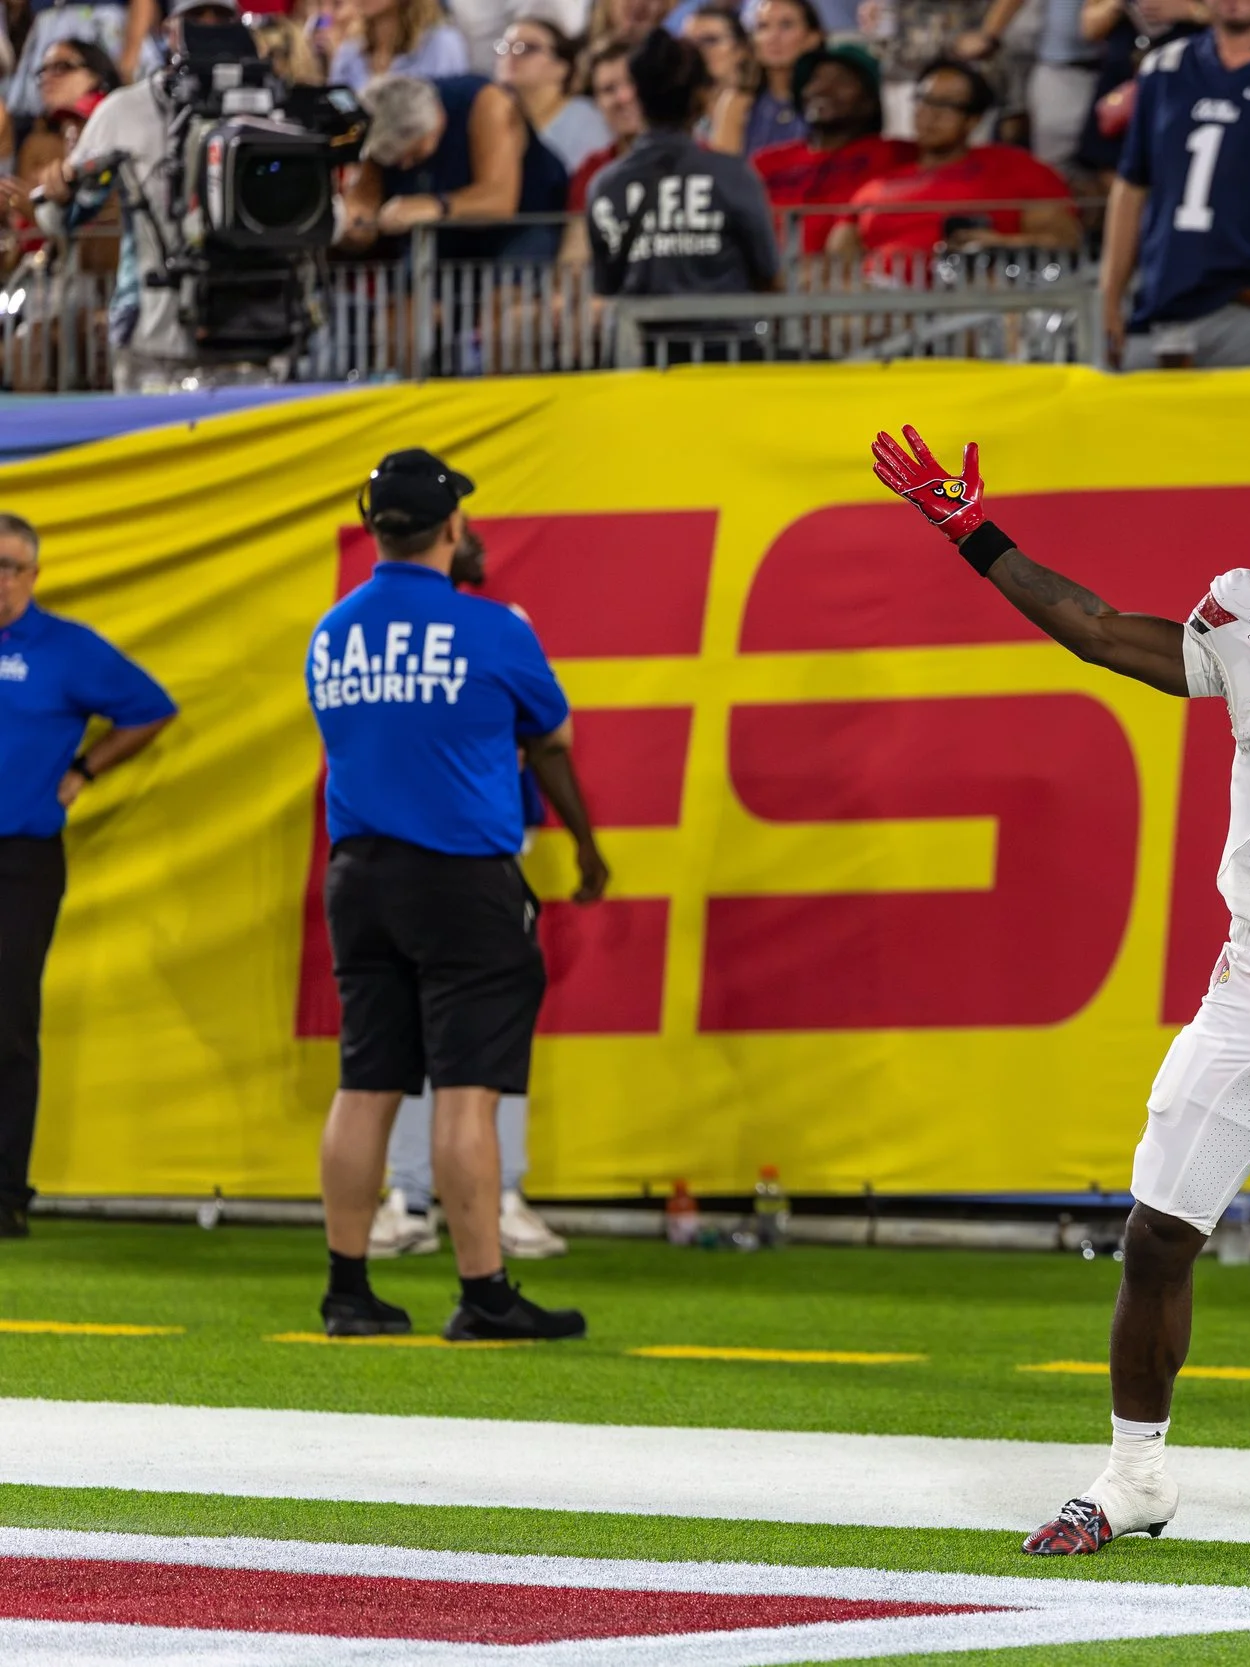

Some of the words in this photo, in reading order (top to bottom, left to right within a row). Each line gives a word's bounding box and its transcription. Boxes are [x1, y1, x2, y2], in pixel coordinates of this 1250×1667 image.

[1174, 123, 1226, 232] 1
[312, 621, 468, 682] S.A.F.E.
[314, 672, 466, 711] SECURITY
